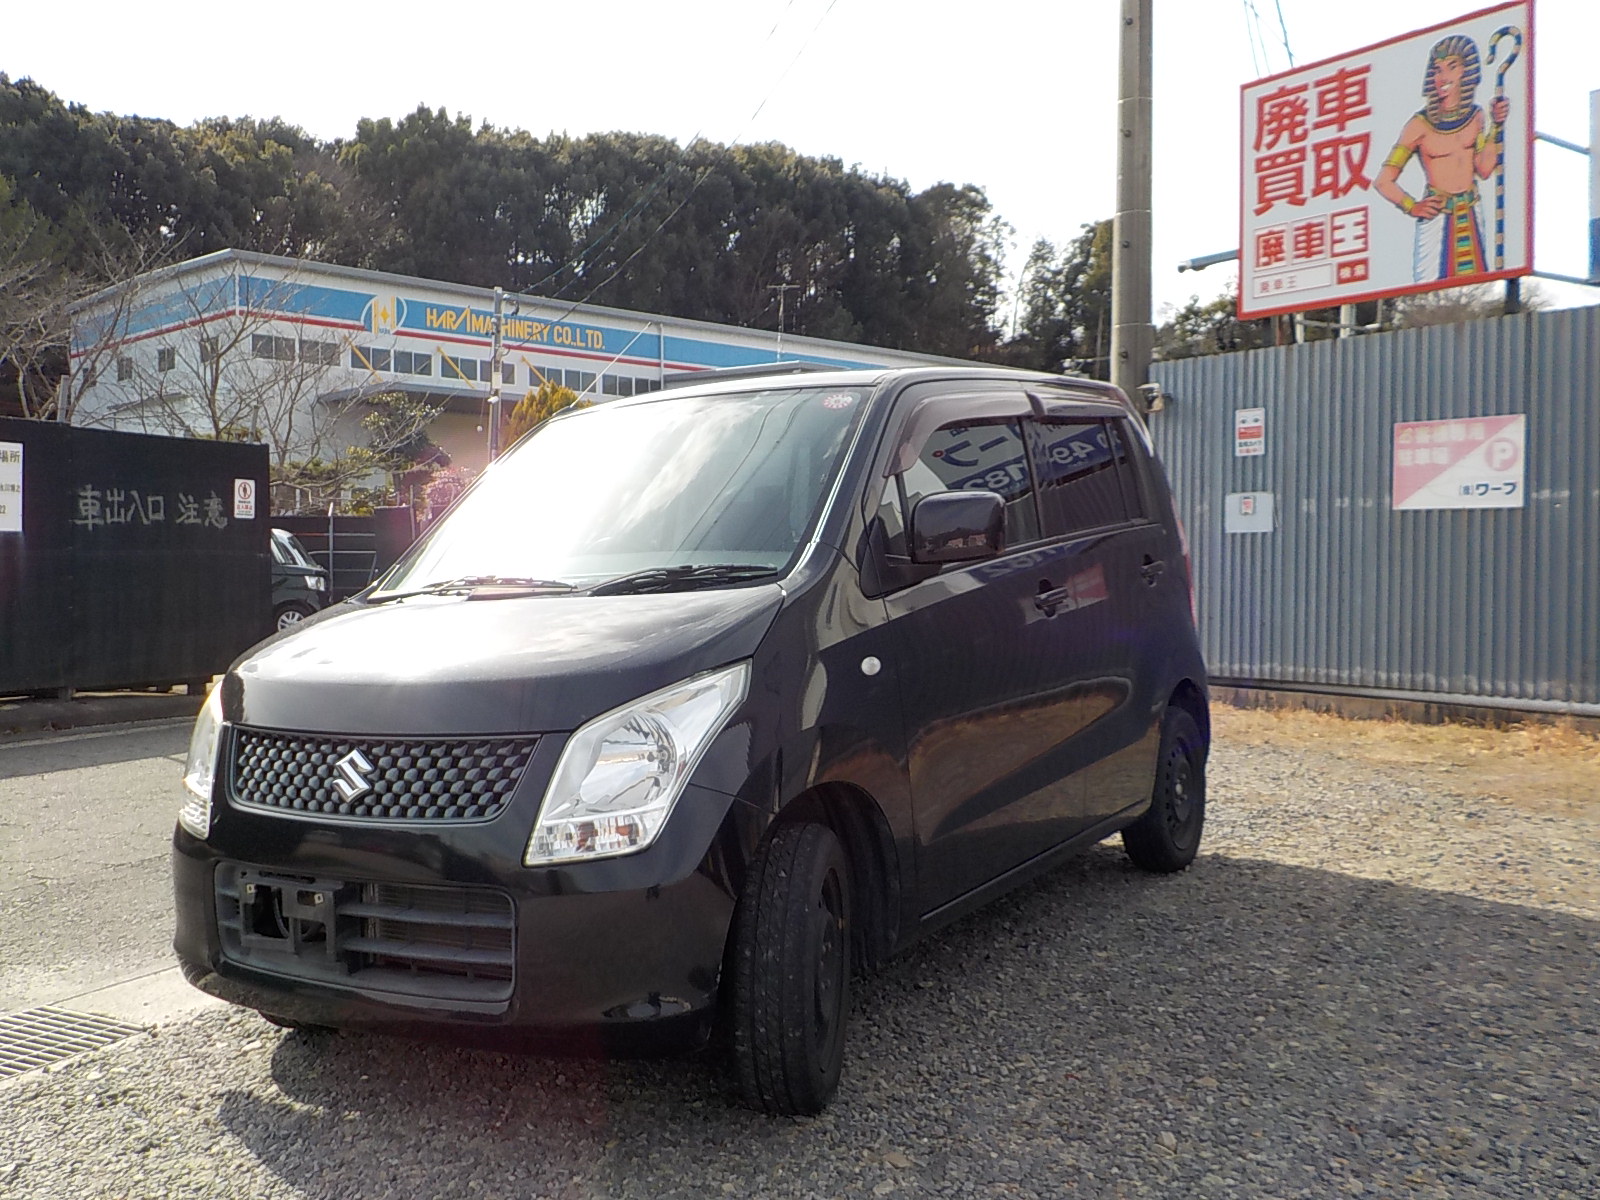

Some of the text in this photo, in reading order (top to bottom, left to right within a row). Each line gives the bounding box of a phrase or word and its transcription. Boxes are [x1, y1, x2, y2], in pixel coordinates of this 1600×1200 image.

[1253, 64, 1372, 152] 廃車
[1253, 131, 1372, 216] 買取
[1255, 206, 1369, 268] 廃車王
[472, 314, 551, 343] MAHINERY
[70, 484, 228, 531] 車出入口 注意
